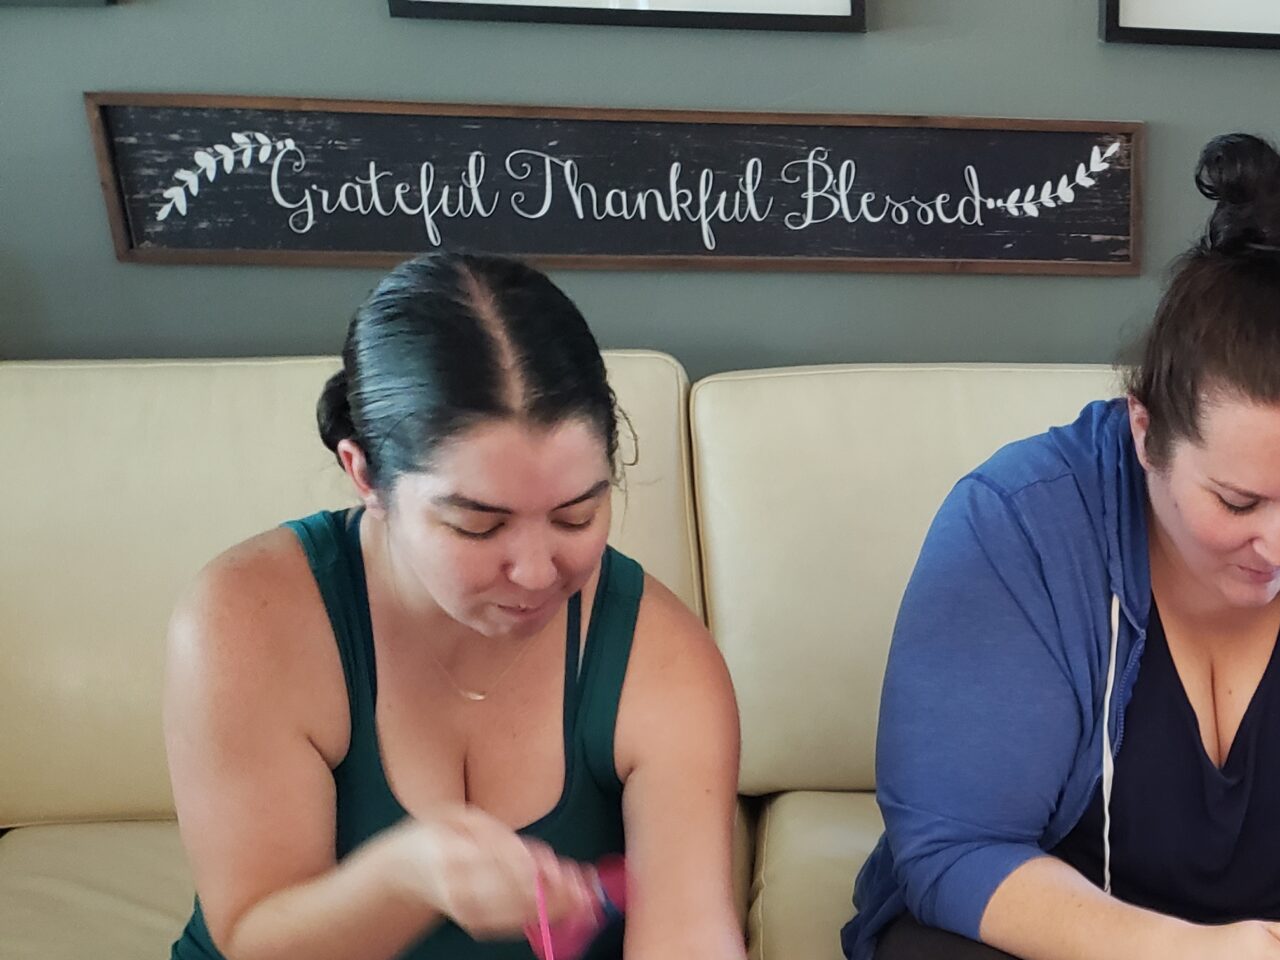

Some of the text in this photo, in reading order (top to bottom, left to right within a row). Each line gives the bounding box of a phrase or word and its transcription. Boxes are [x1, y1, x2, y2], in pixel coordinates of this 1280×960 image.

[270, 147, 984, 250] Grateful Thankful Blessed
